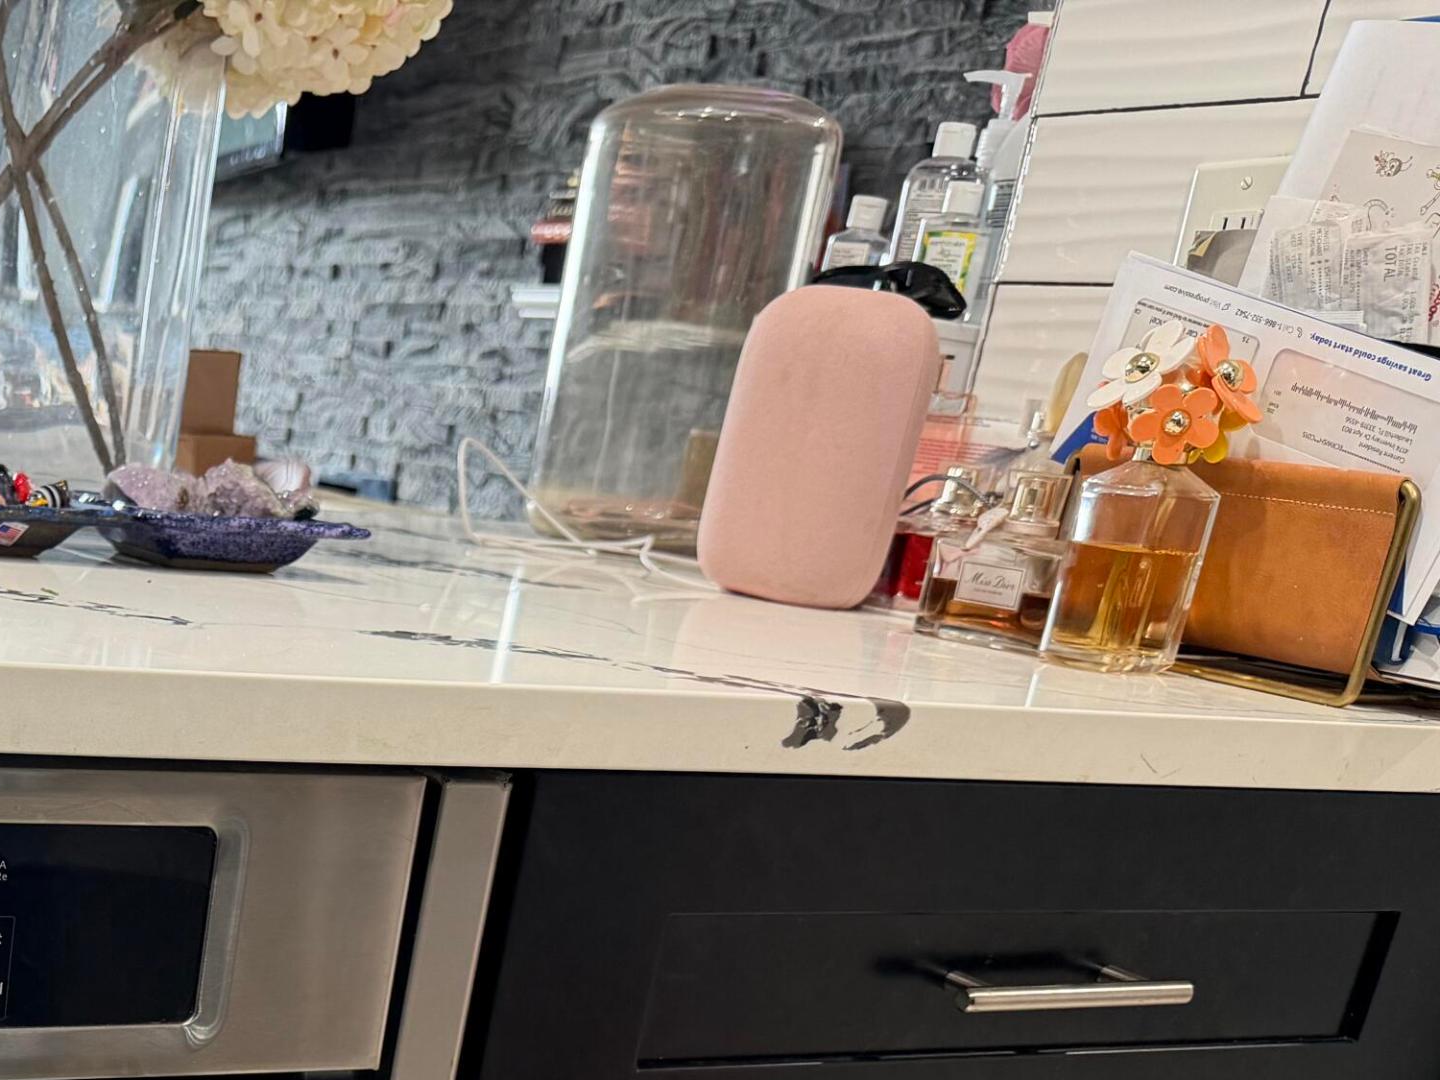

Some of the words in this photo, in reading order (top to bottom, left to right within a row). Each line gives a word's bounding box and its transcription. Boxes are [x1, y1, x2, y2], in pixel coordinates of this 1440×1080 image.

[1383, 246, 1397, 282] TOTAL
[1310, 332, 1332, 347] today.
[1333, 342, 1352, 353] start
[1353, 349, 1376, 361] could
[1376, 356, 1408, 372] savings
[1408, 367, 1432, 381] Great
